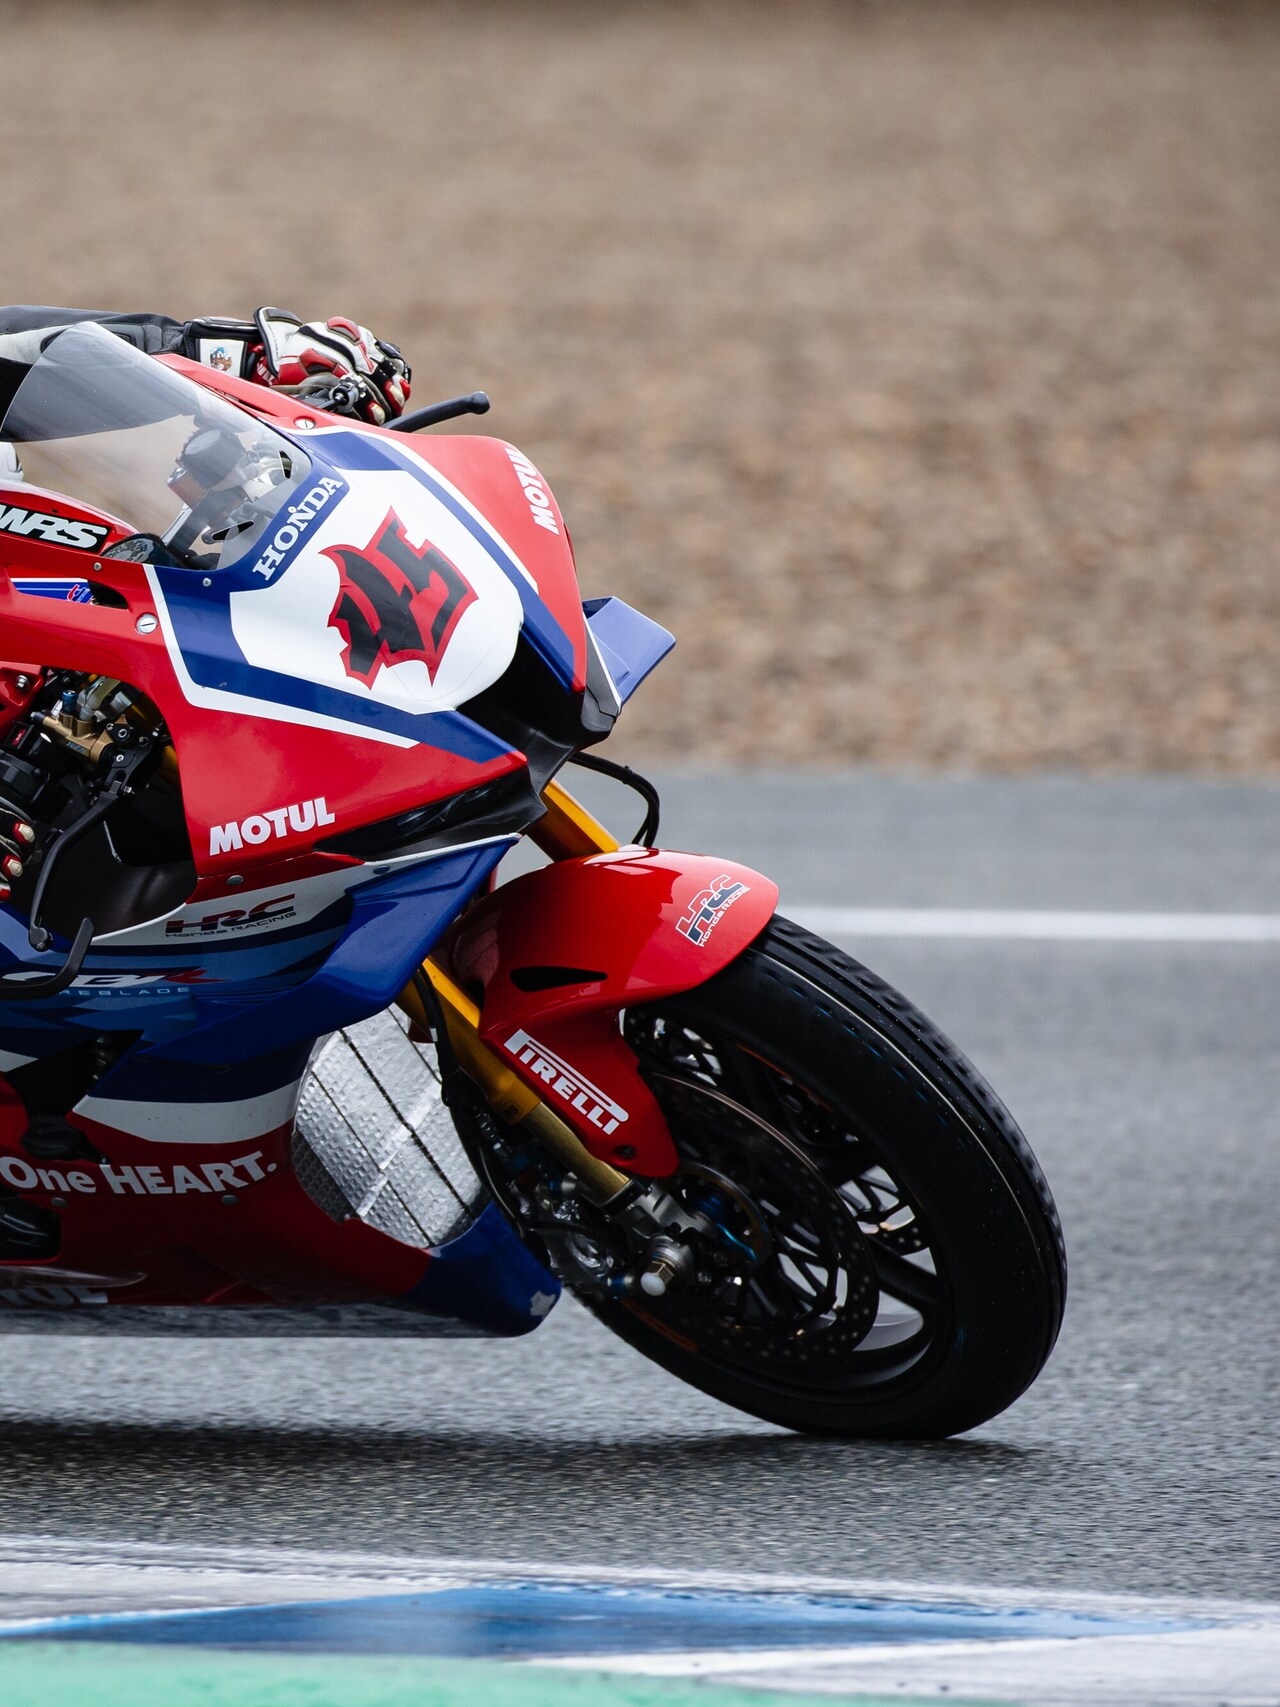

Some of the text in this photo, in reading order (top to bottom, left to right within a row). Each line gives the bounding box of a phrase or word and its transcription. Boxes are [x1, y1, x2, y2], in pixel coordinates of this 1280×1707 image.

[252, 475, 343, 581] HONDA
[209, 797, 336, 856] MOTUL
[164, 893, 296, 934] HRC
[165, 911, 297, 938] Honda RACING
[675, 874, 745, 945] HRC
[699, 911, 724, 947] Honda
[58, 986, 190, 997] REBLADE
[504, 1029, 630, 1135] PIRELLI
[100, 1150, 278, 1196] HEART.
